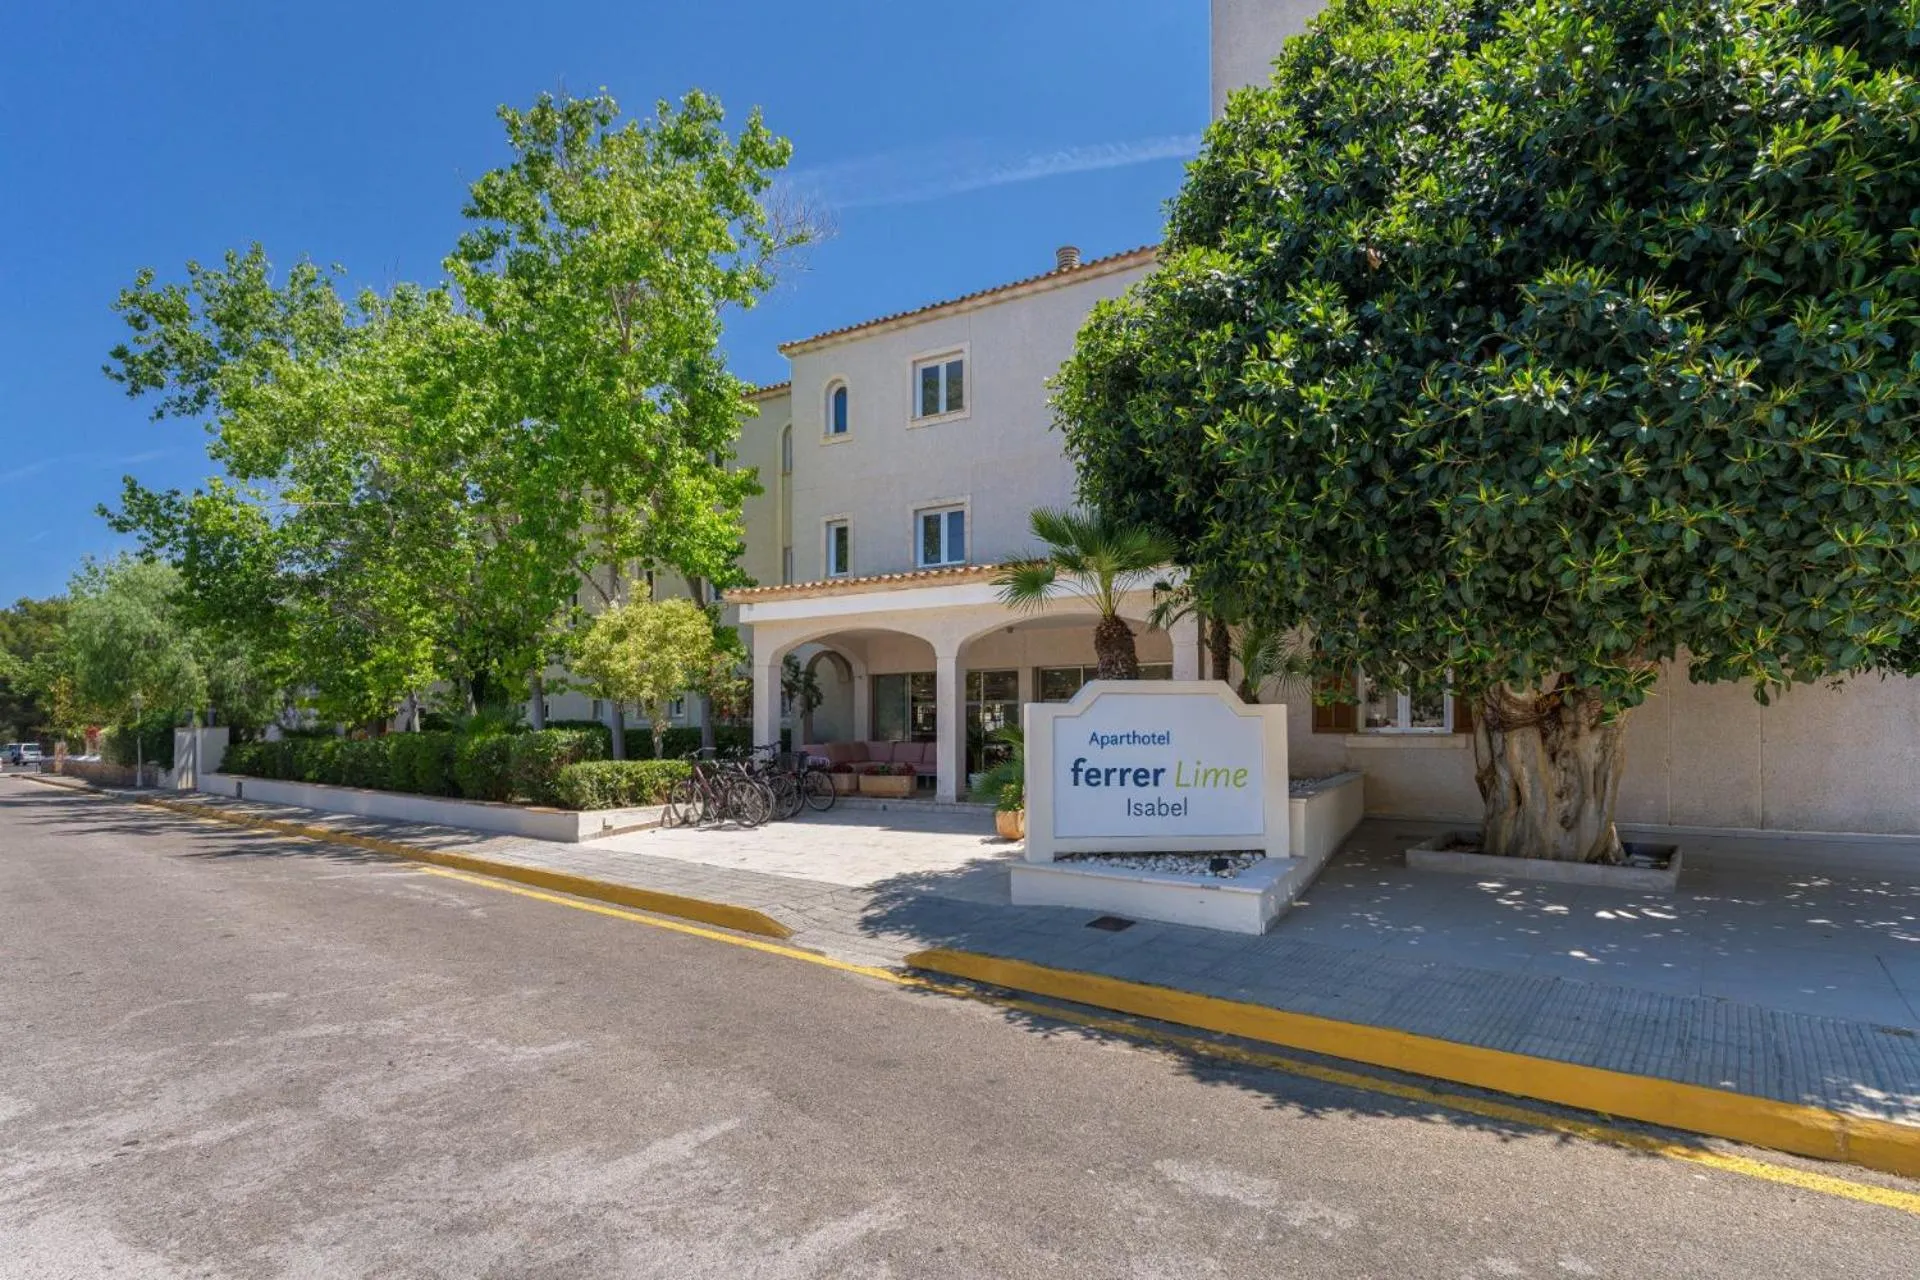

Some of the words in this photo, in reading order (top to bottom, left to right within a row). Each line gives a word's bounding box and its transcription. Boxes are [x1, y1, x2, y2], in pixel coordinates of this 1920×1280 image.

[1089, 730, 1170, 749] Aparthotel
[1071, 758, 1166, 787] ferrer
[1175, 761, 1248, 788] Lime
[1127, 797, 1188, 816] Isabel
